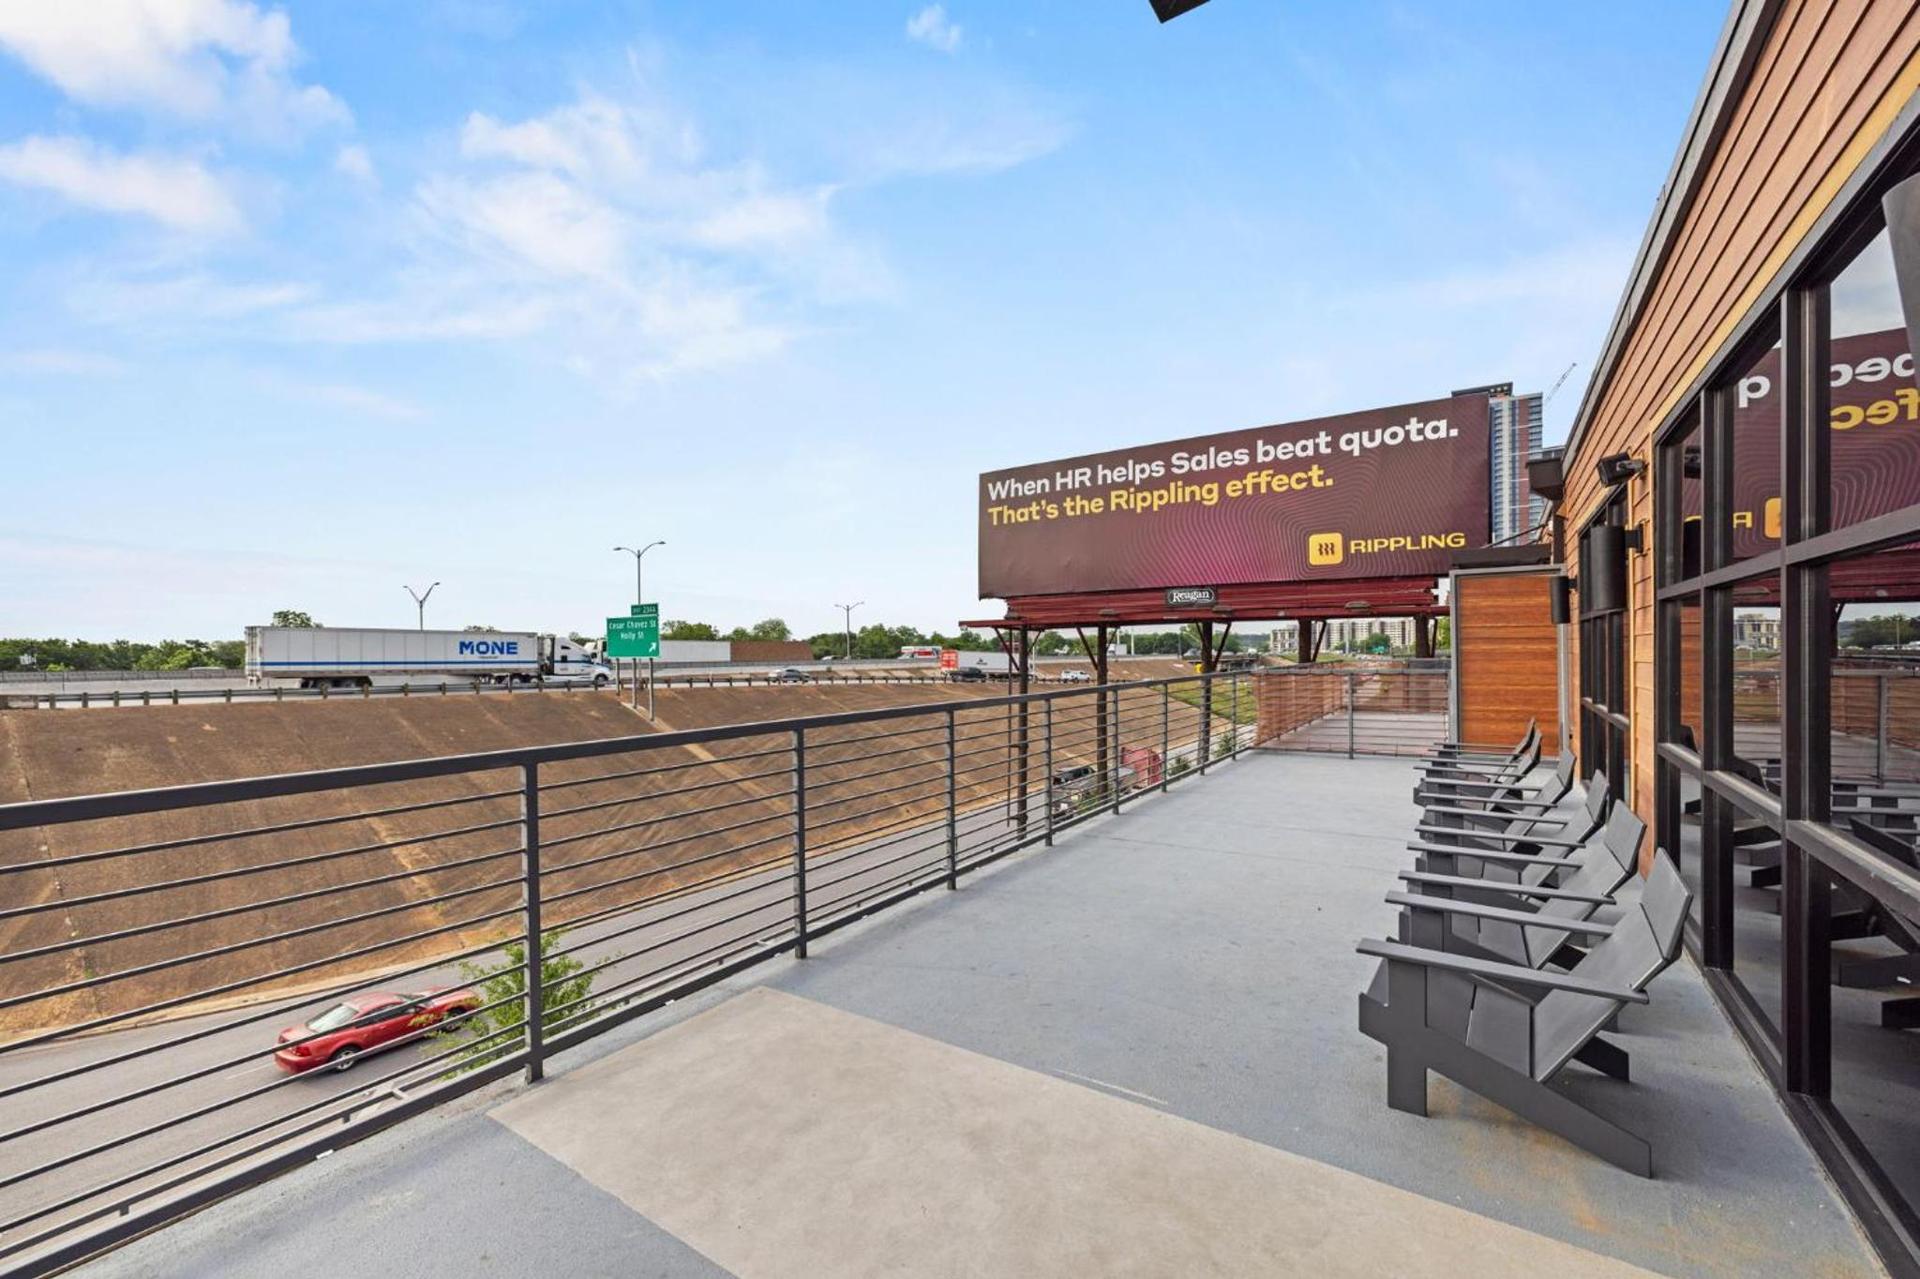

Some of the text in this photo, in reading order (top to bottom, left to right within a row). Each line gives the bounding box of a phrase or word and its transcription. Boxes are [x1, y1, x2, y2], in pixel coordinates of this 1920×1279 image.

[988, 416, 1459, 501] When HR helps Sales beat quota.
[987, 464, 1334, 526] That's the Rippling effect.
[1349, 532, 1467, 554] RIPPLING
[1172, 591, 1210, 603] Reagan
[609, 622, 625, 630] Cesar
[627, 621, 647, 629] Chavez
[620, 631, 636, 641] Holly
[459, 640, 518, 655] MONE
